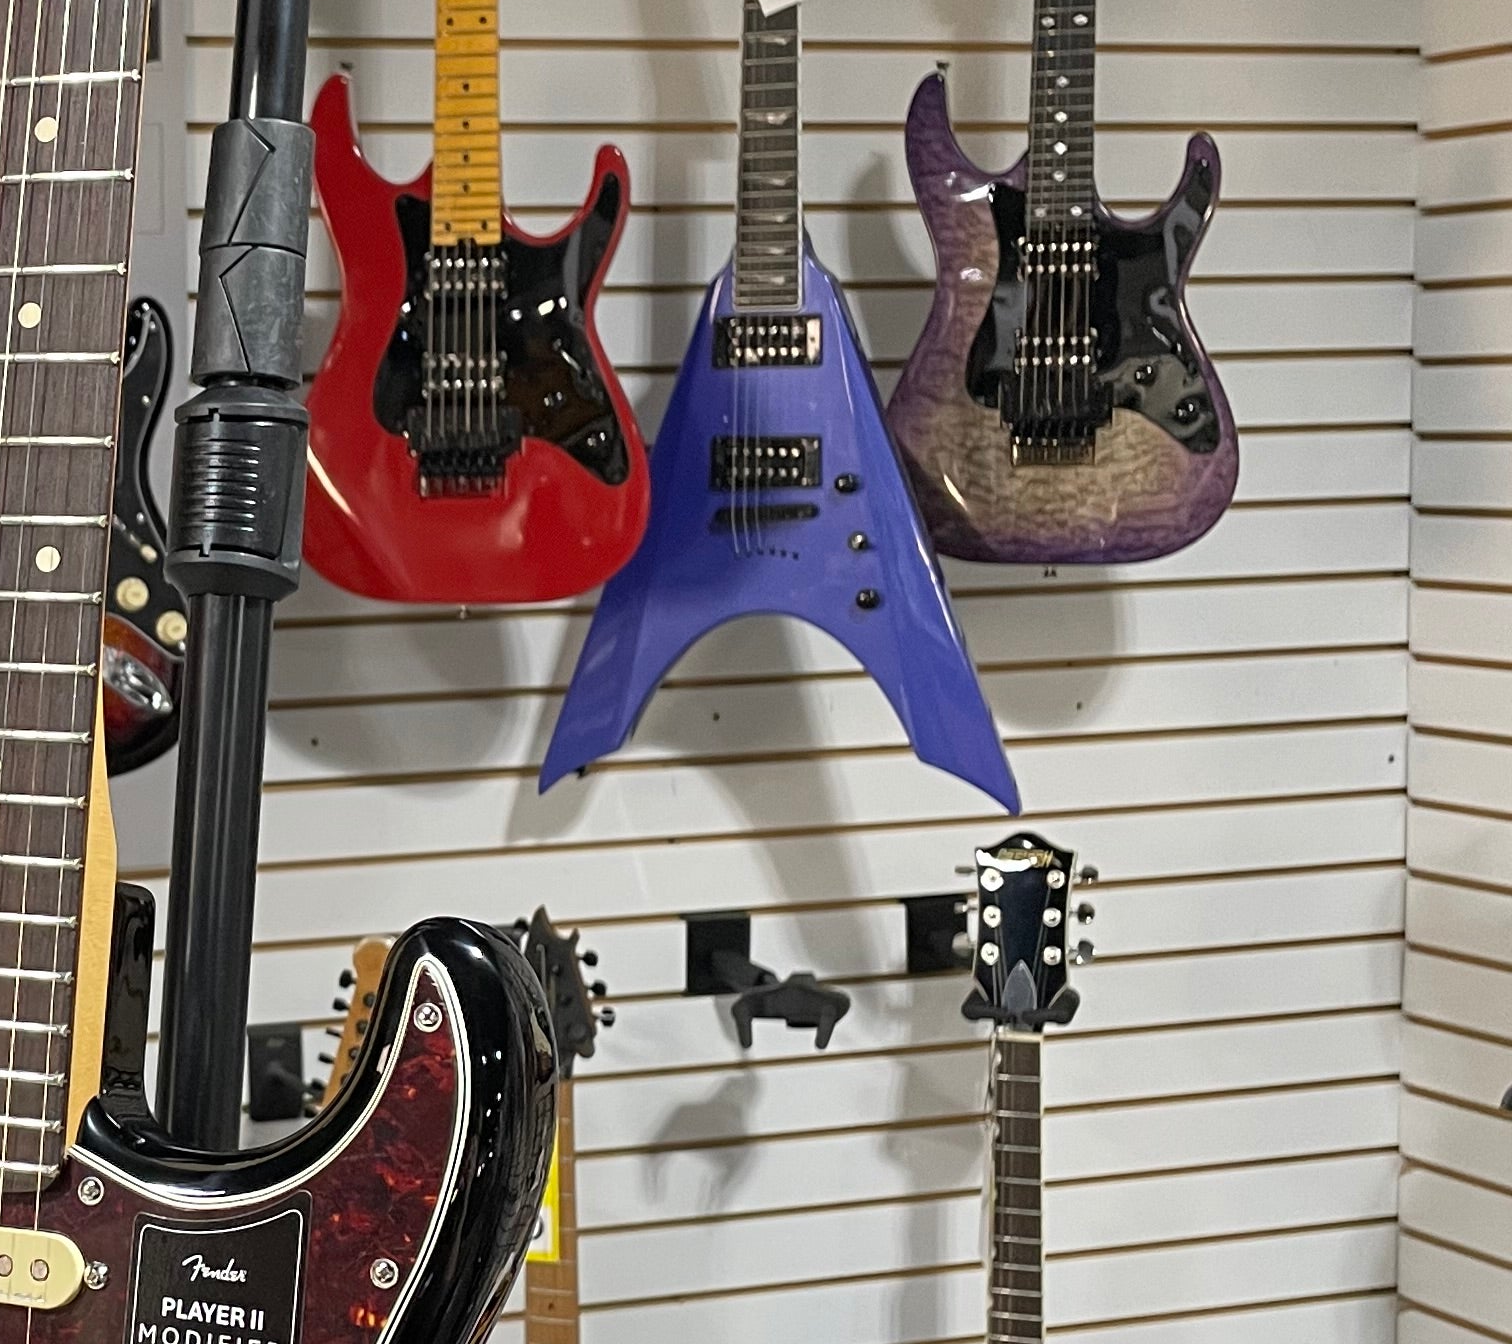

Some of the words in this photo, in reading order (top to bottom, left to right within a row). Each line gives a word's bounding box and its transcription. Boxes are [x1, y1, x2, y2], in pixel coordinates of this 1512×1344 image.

[181, 1254, 248, 1283] Fender
[161, 1296, 245, 1328] PLAYER
[249, 1309, 264, 1331] II
